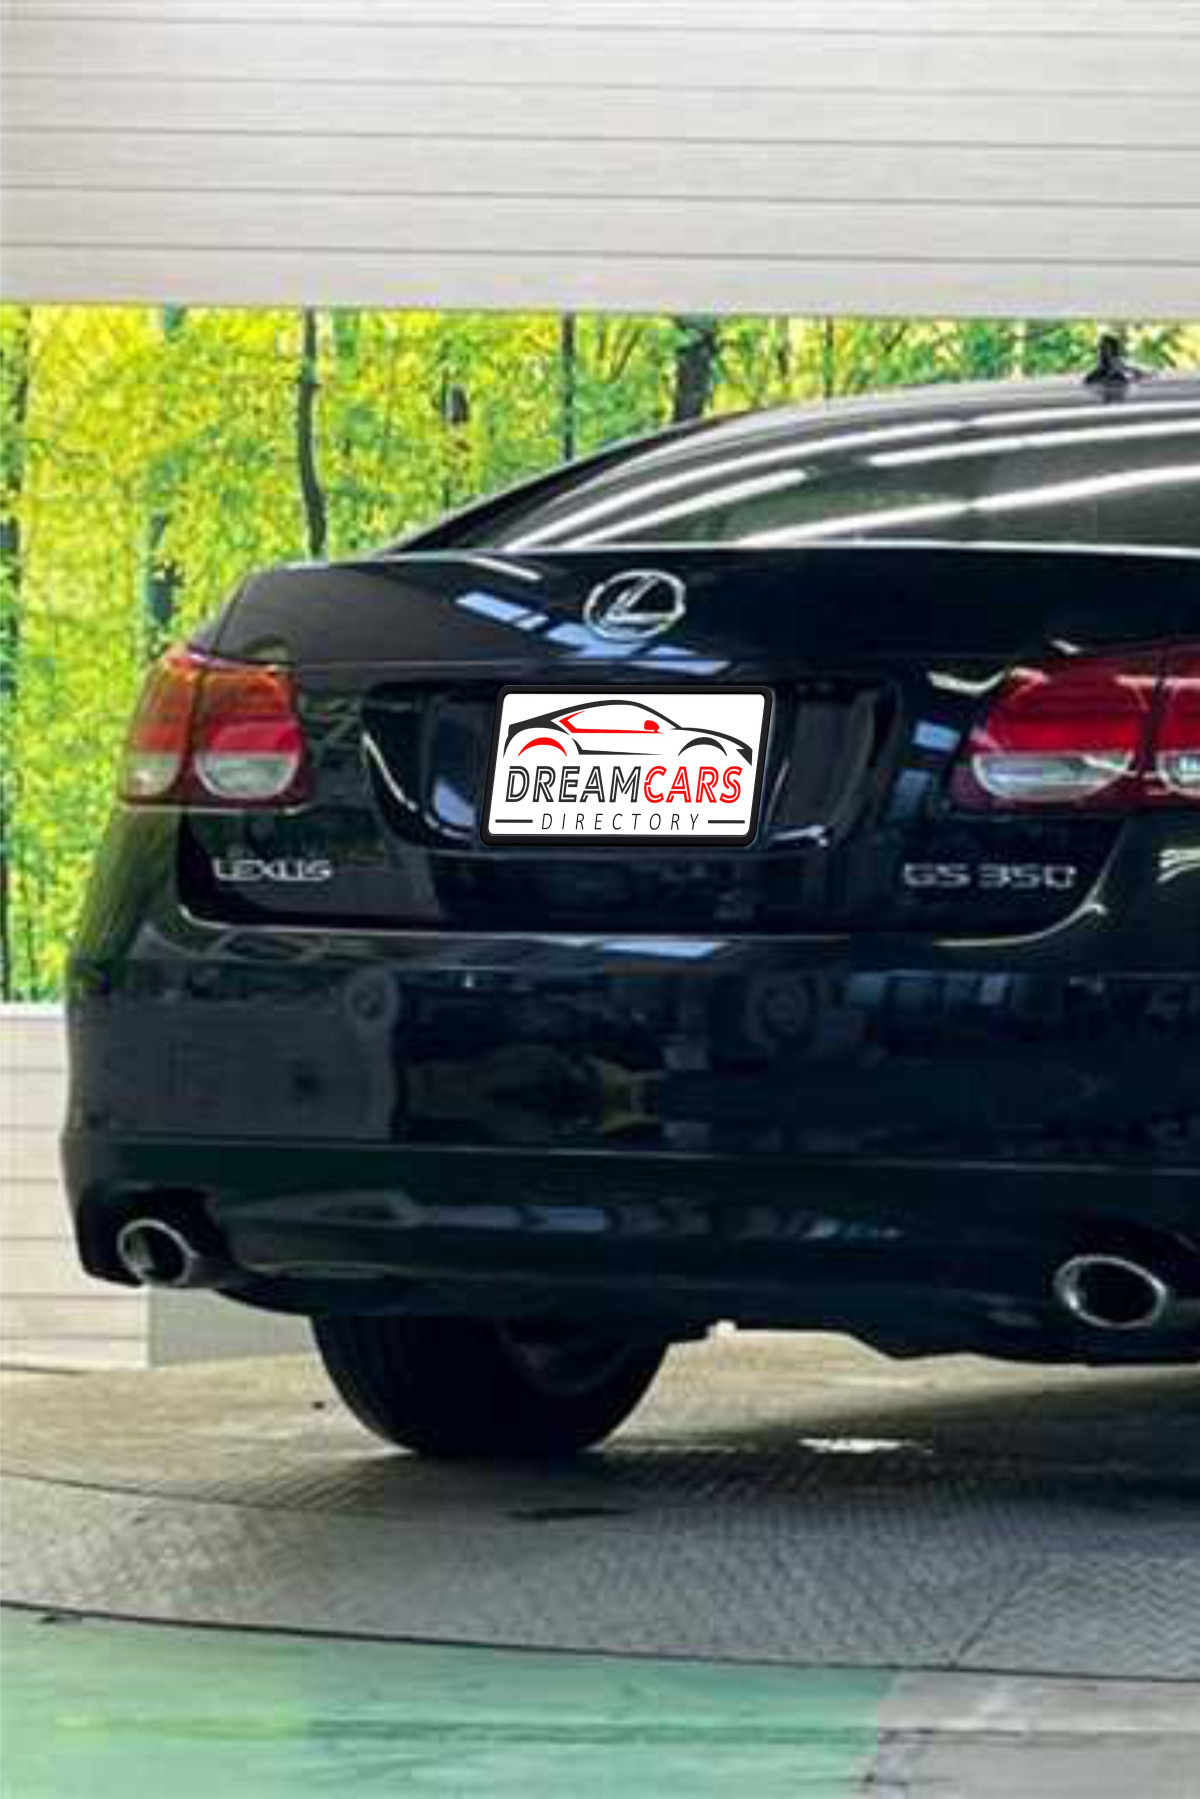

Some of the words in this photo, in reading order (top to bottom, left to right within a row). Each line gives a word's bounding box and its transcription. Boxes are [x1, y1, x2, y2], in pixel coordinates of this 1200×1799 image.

[212, 858, 332, 882] LEXUS
[903, 862, 971, 888] GS
[978, 862, 1077, 890] 350
